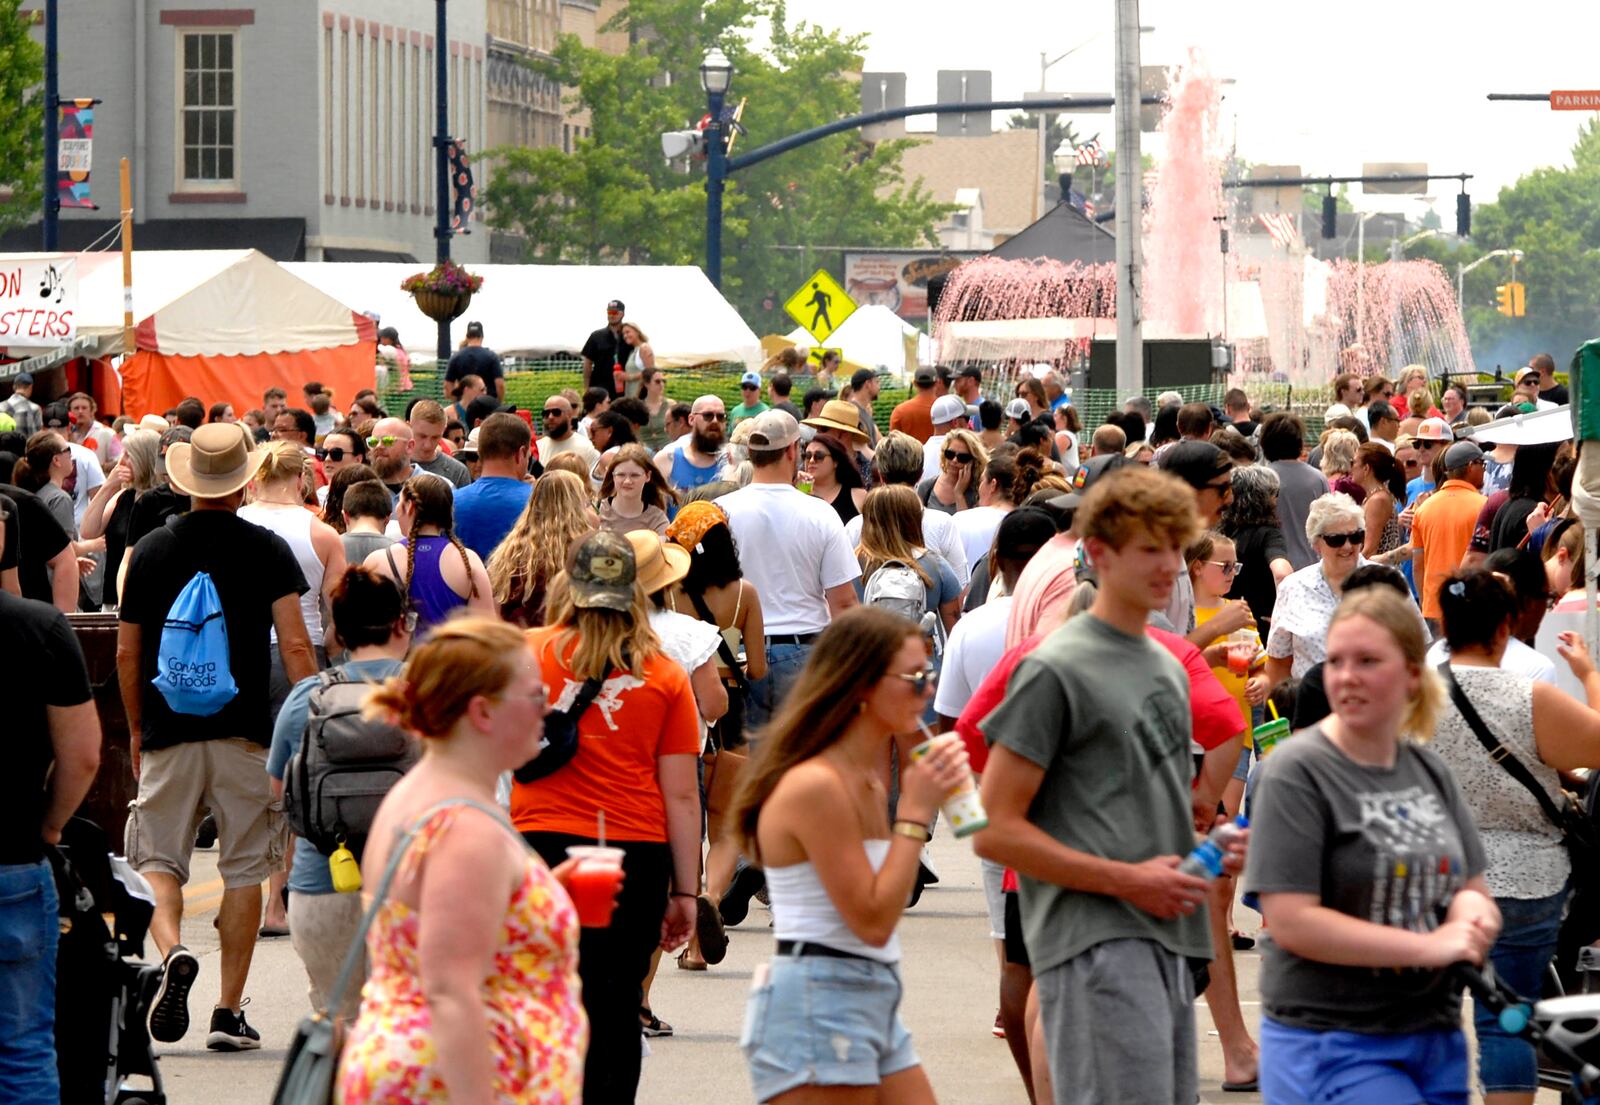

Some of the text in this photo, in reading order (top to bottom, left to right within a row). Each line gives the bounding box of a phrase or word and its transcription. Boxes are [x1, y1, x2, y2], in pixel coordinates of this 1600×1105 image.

[0, 308, 73, 338] STERS
[168, 656, 216, 678] ConAgra
[180, 673, 217, 687] Foods
